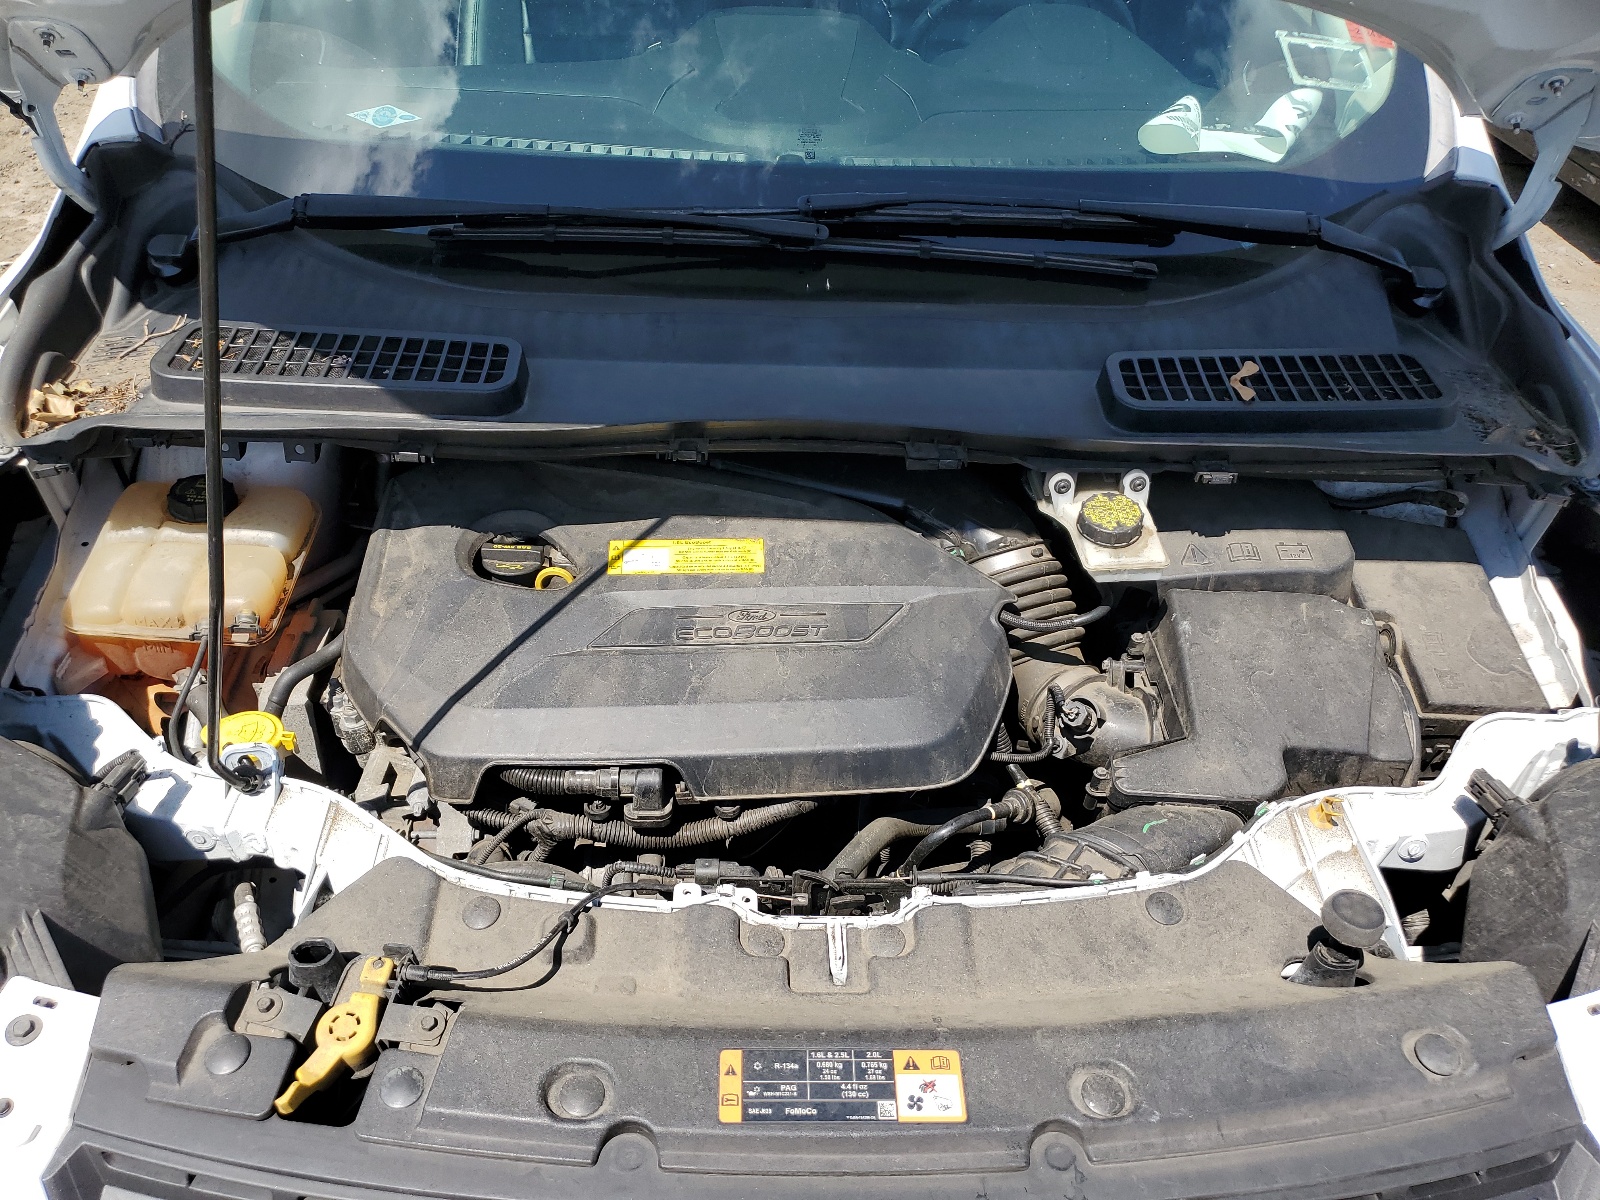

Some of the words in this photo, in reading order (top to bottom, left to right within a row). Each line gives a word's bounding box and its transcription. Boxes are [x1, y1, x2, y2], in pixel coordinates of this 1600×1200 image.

[737, 611, 768, 621] Ford
[675, 624, 829, 641] ECOBOOST
[834, 1061, 843, 1070] kg
[878, 1061, 888, 1070] kg
[857, 1090, 869, 1098] cc)
[785, 1107, 817, 1115] FoMoCo
